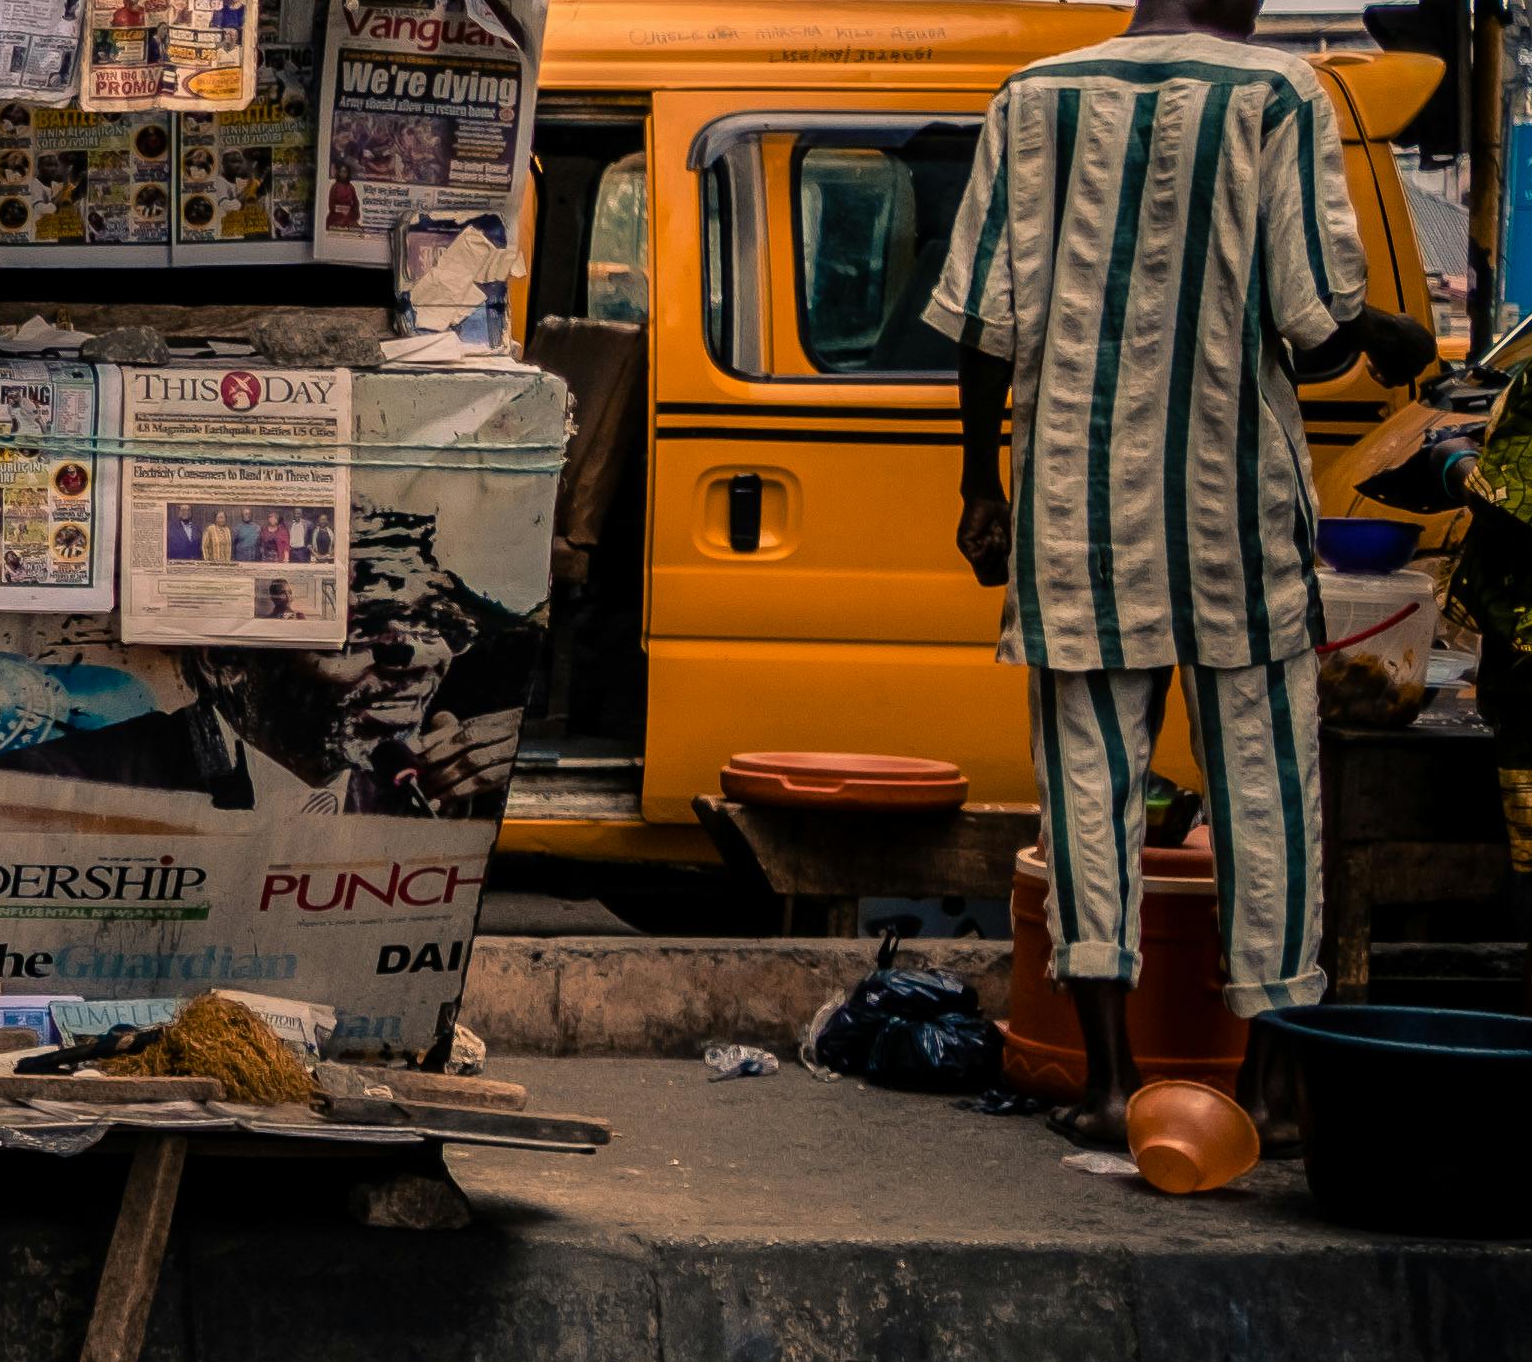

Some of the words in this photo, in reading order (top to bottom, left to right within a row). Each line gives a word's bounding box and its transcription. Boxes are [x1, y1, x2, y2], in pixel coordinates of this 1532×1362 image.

[95, 81, 157, 96] PROMO
[343, 60, 429, 98] We're
[432, 69, 518, 106] dying
[134, 373, 219, 402] THIS
[261, 375, 335, 405] DAY
[205, 425, 258, 437] Earthquake
[133, 466, 174, 482] Electricity
[177, 467, 227, 482] Consumers
[228, 469, 237, 482] to
[239, 468, 262, 482] Band
[285, 469, 309, 483] Three
[310, 471, 335, 485] Years
